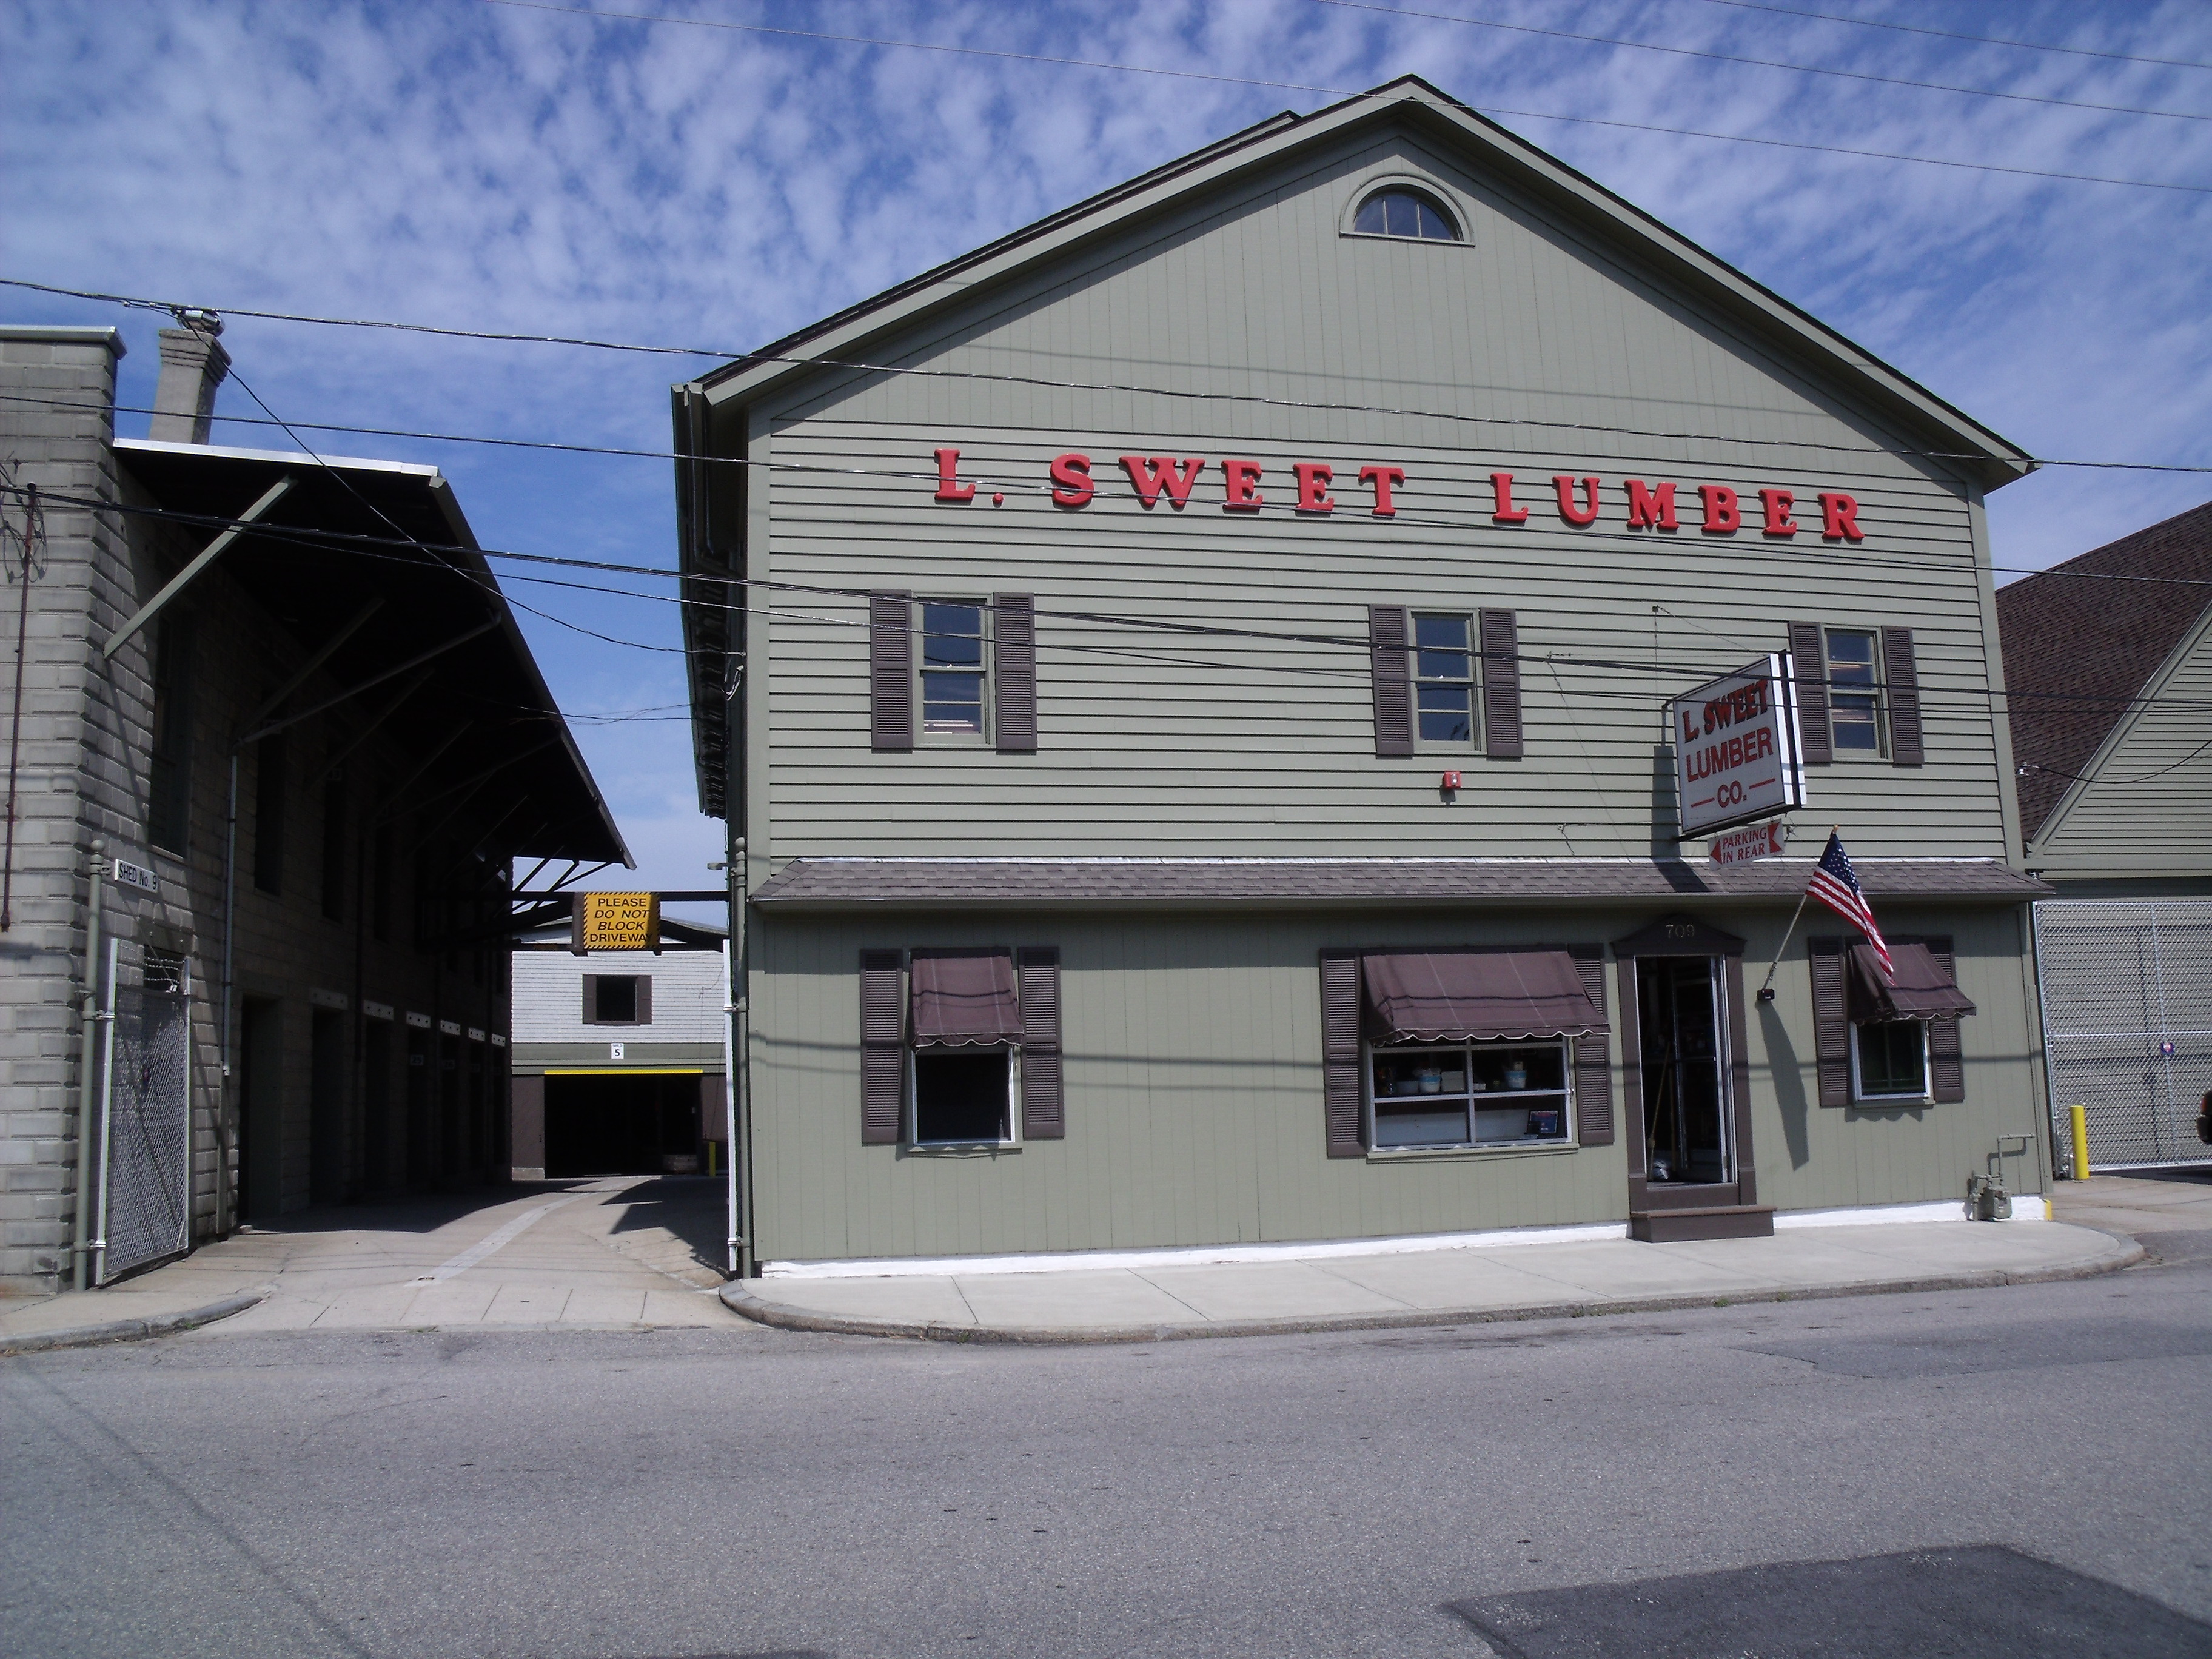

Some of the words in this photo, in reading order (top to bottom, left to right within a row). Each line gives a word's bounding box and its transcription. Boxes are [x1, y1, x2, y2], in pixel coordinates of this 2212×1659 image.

[934, 448, 1004, 505] L.
[1050, 453, 1406, 517] SWEET
[1490, 472, 1865, 541] LUMBER
[1704, 679, 1768, 735] SWEET
[1686, 726, 1774, 782] LUMBER
[1717, 780, 1747, 808] CO.
[1723, 827, 1766, 849] PARKING
[1723, 851, 1733, 864] IN
[1738, 843, 1765, 860] REAR
[119, 863, 137, 883] SHED
[152, 875, 157, 890] 9
[598, 898, 646, 907] PLEASE
[594, 910, 615, 919] DO
[598, 922, 645, 930] BLOCK
[1666, 924, 1695, 939] 709
[615, 1048, 620, 1057] 5
